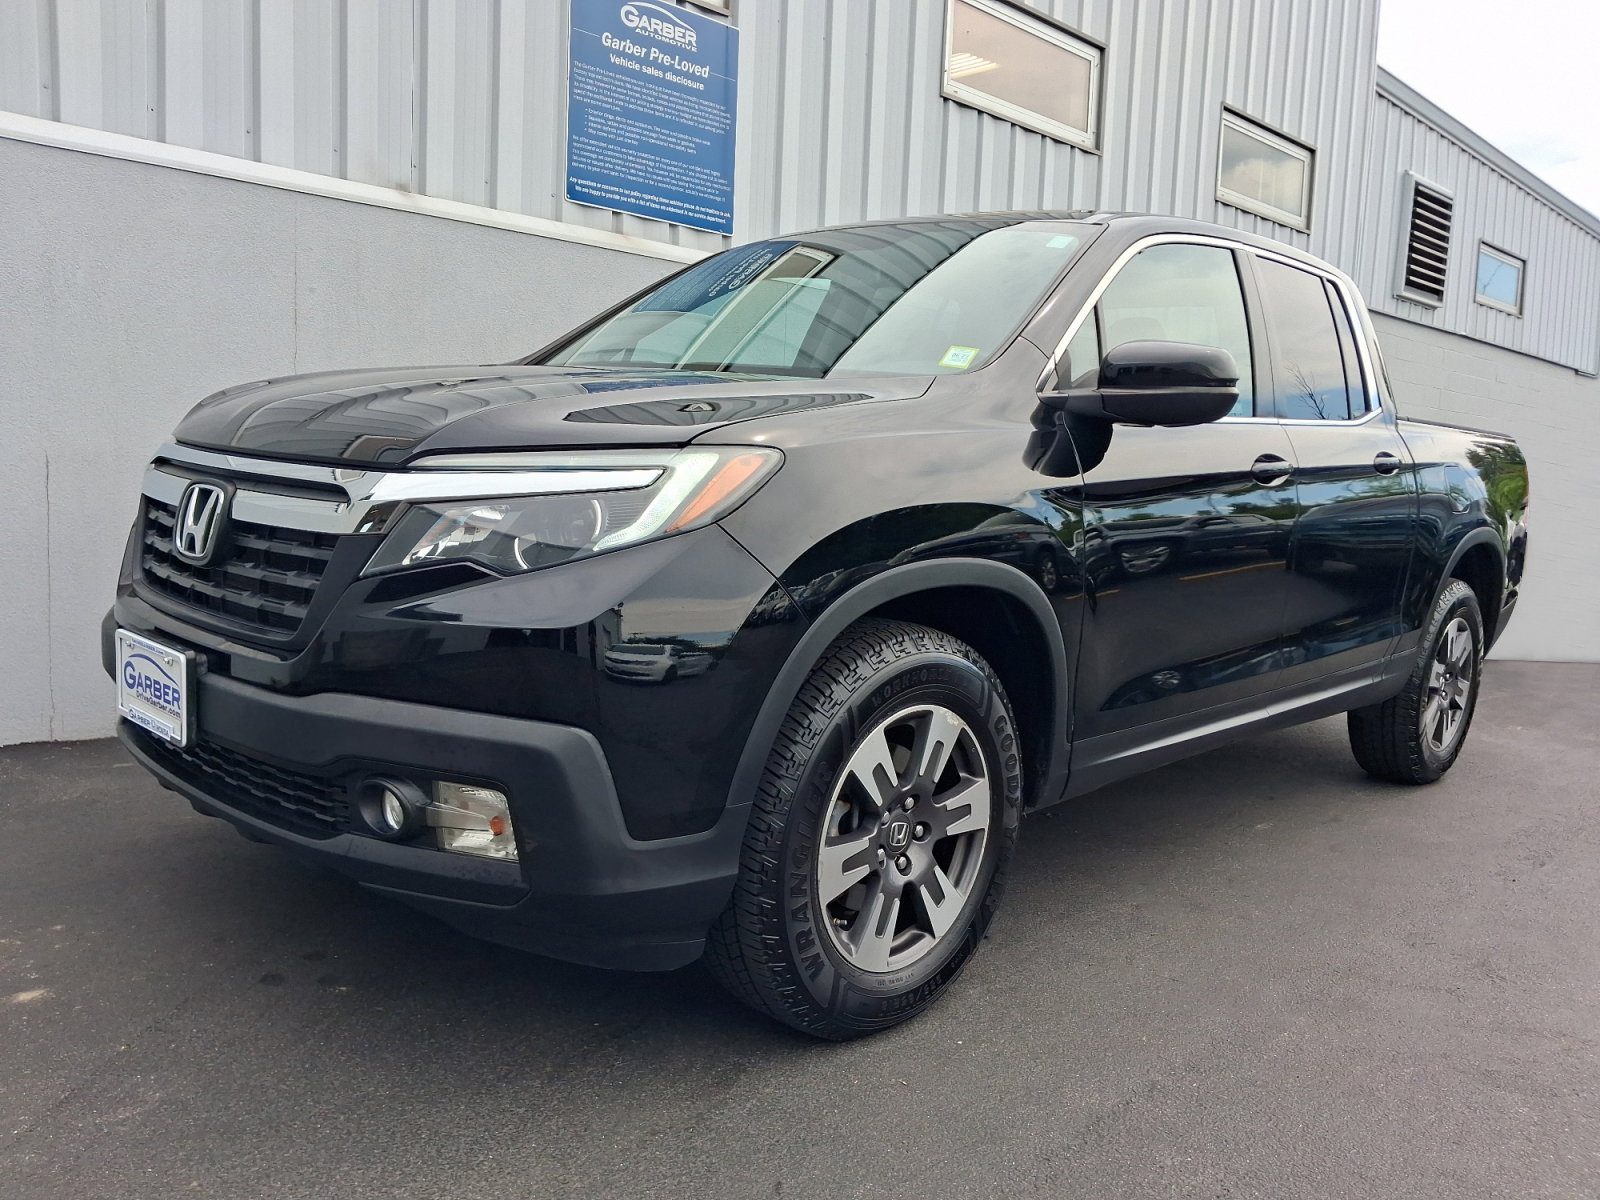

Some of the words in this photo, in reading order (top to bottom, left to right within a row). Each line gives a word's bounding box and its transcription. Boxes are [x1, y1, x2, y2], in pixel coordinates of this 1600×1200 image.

[621, 5, 697, 46] GARBER
[635, 28, 697, 53] AUTOMOTIVE
[602, 32, 647, 58] Garber
[650, 47, 710, 79] Pre-Loved
[610, 53, 641, 71] Vehicle
[642, 65, 663, 78] sales
[665, 72, 704, 90] disclosure
[124, 661, 181, 710] GARBER
[128, 708, 151, 726] GARBER
